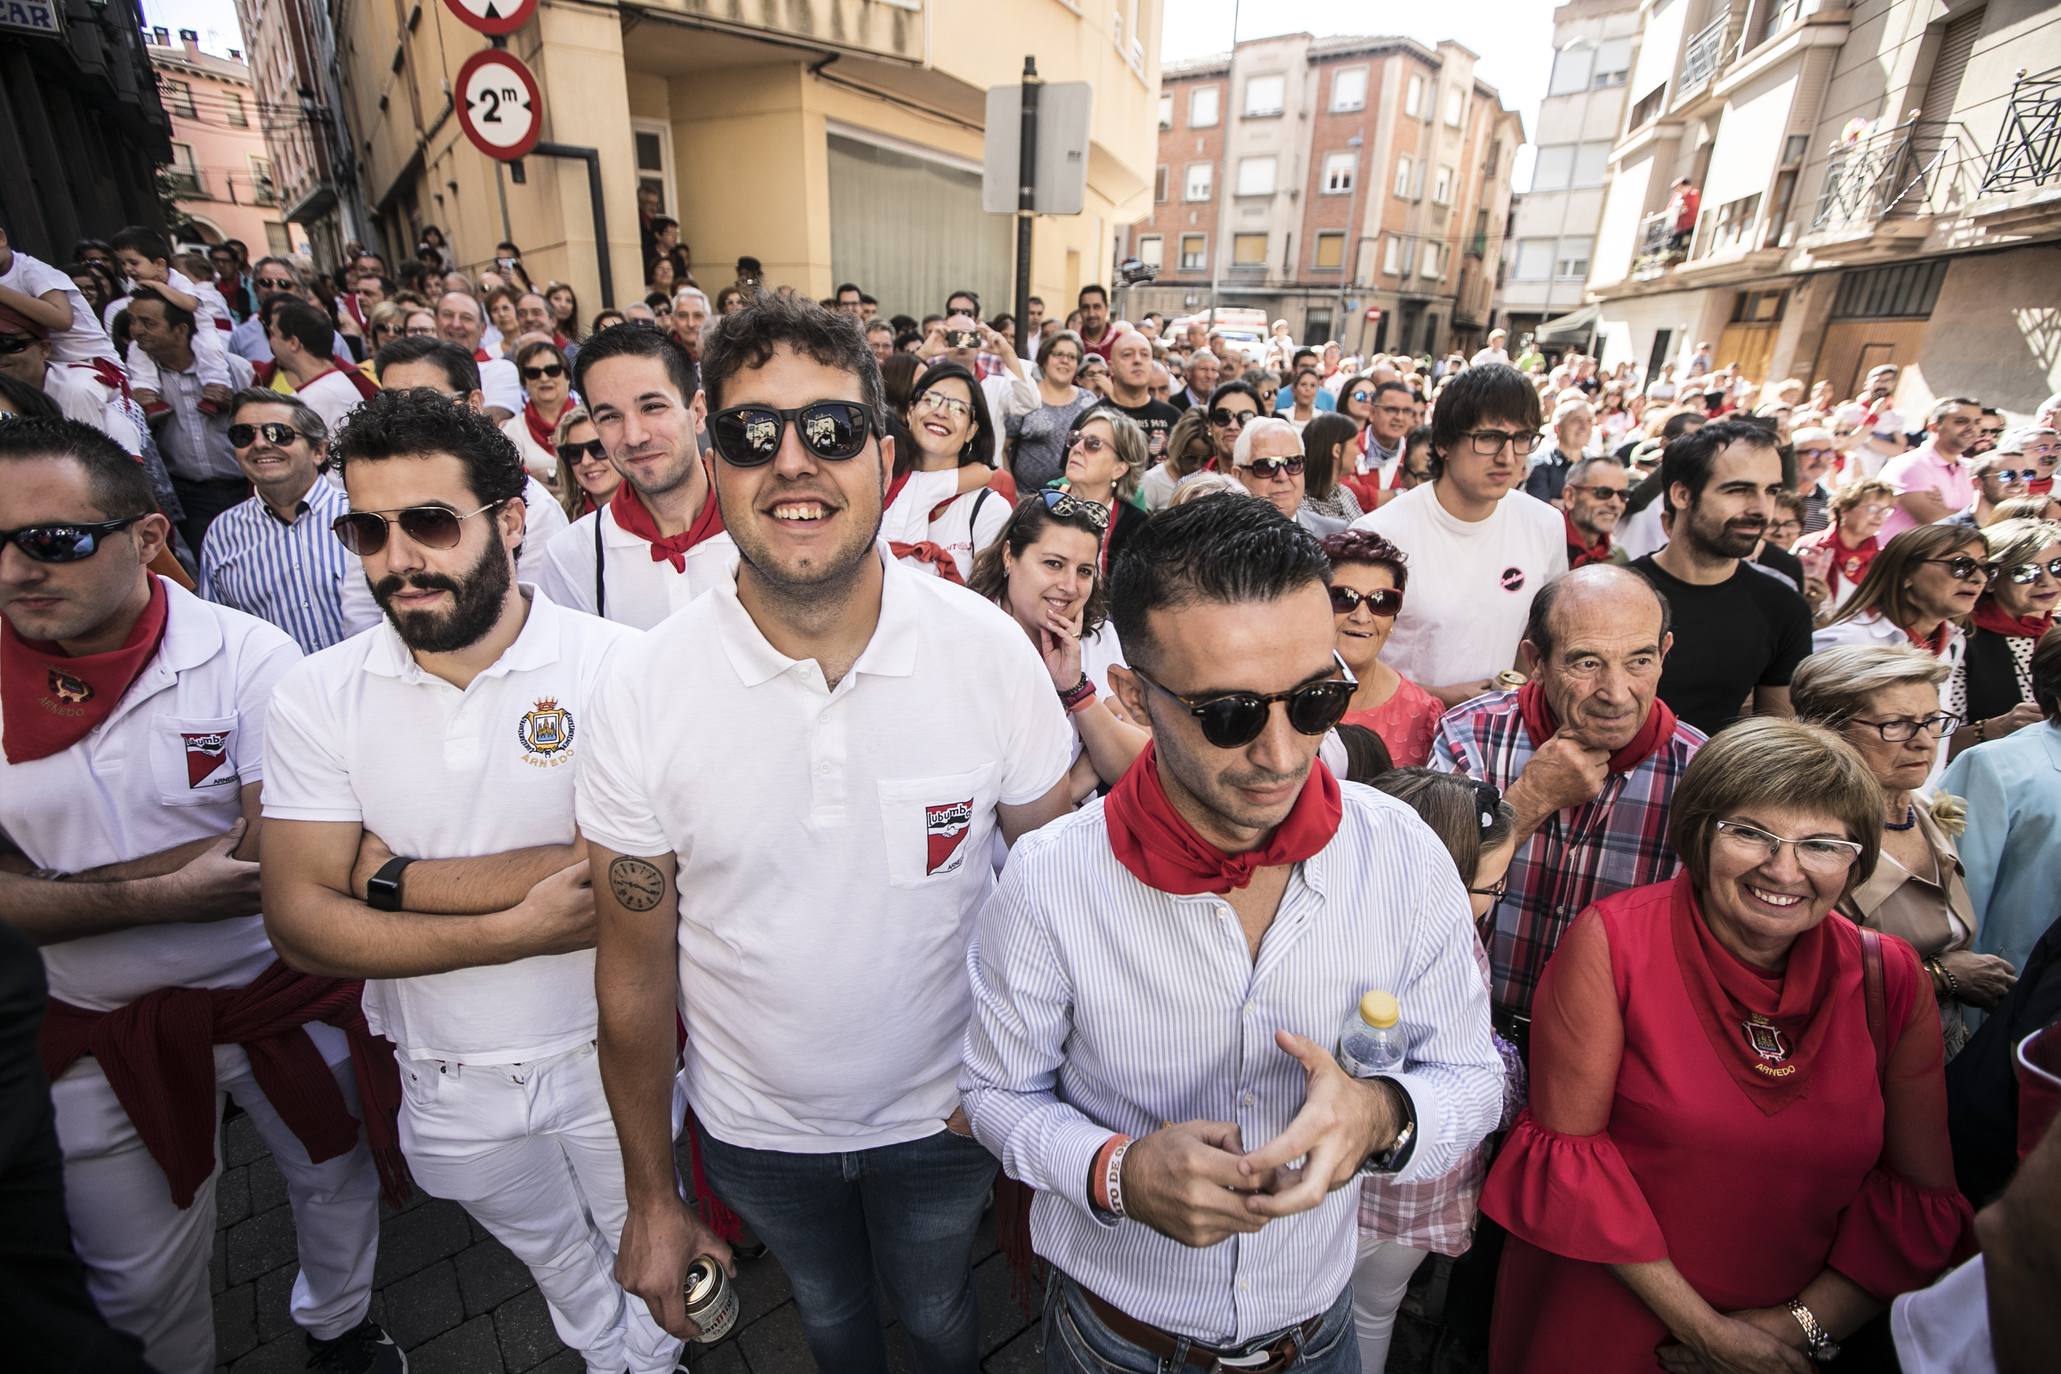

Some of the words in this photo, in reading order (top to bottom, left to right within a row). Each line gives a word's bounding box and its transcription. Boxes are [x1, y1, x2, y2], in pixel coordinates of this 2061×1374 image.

[480, 88, 518, 123] 2m
[38, 697, 85, 717] ARNEDO
[521, 748, 575, 768] ARNEDO
[1755, 1063, 1796, 1077] ARNEDO
[1109, 1161, 1121, 1183] DE
